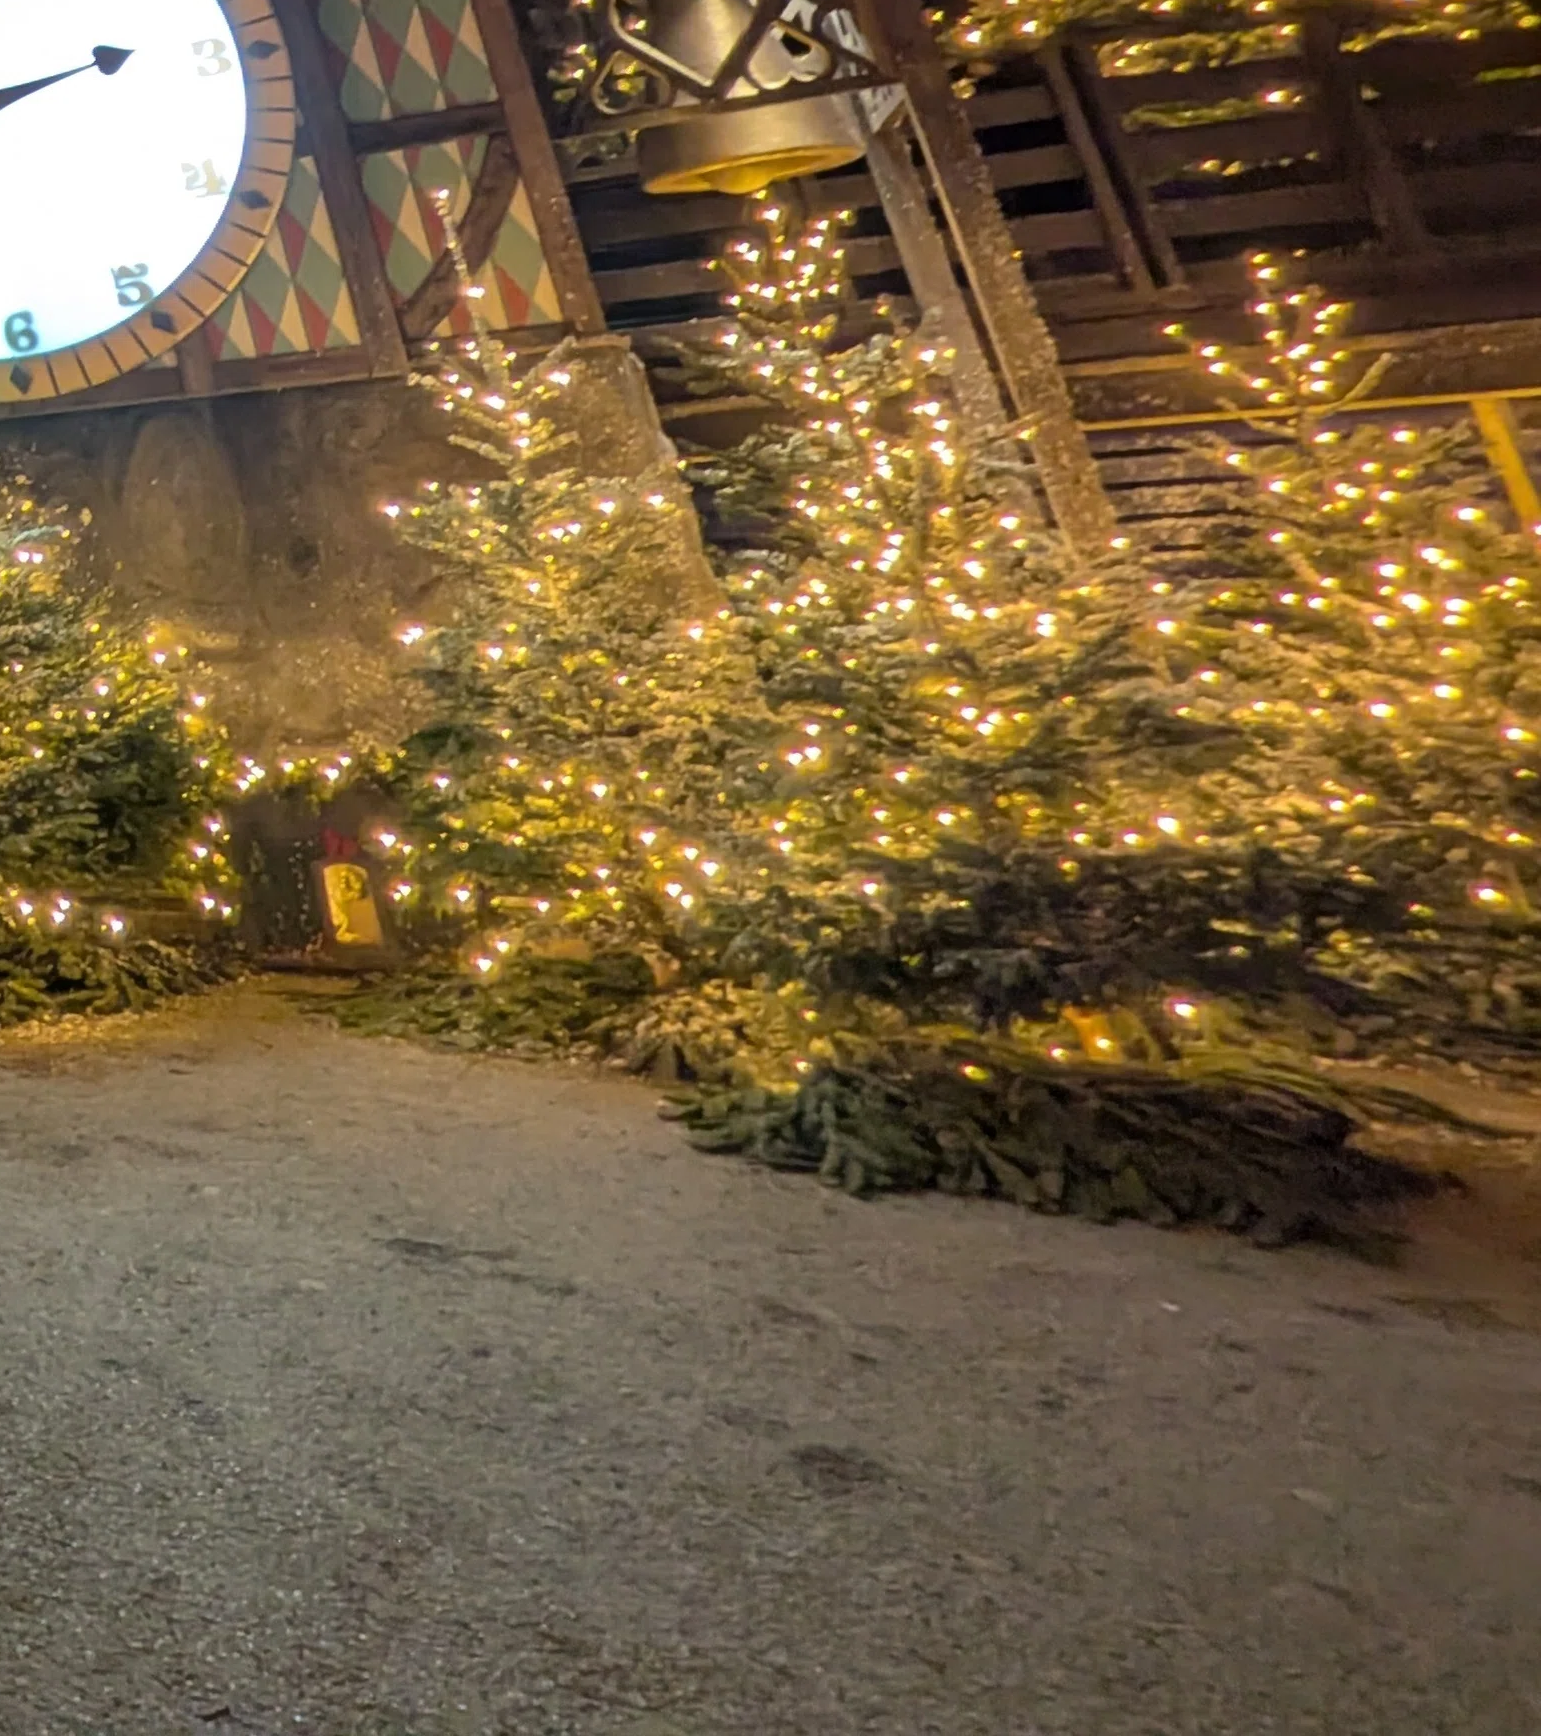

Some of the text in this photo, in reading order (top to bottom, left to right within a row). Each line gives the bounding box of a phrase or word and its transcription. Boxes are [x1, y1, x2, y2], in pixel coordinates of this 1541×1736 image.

[192, 38, 232, 77] 3
[181, 159, 227, 198] 4
[110, 262, 154, 307] 5
[3, 311, 38, 352] 6
